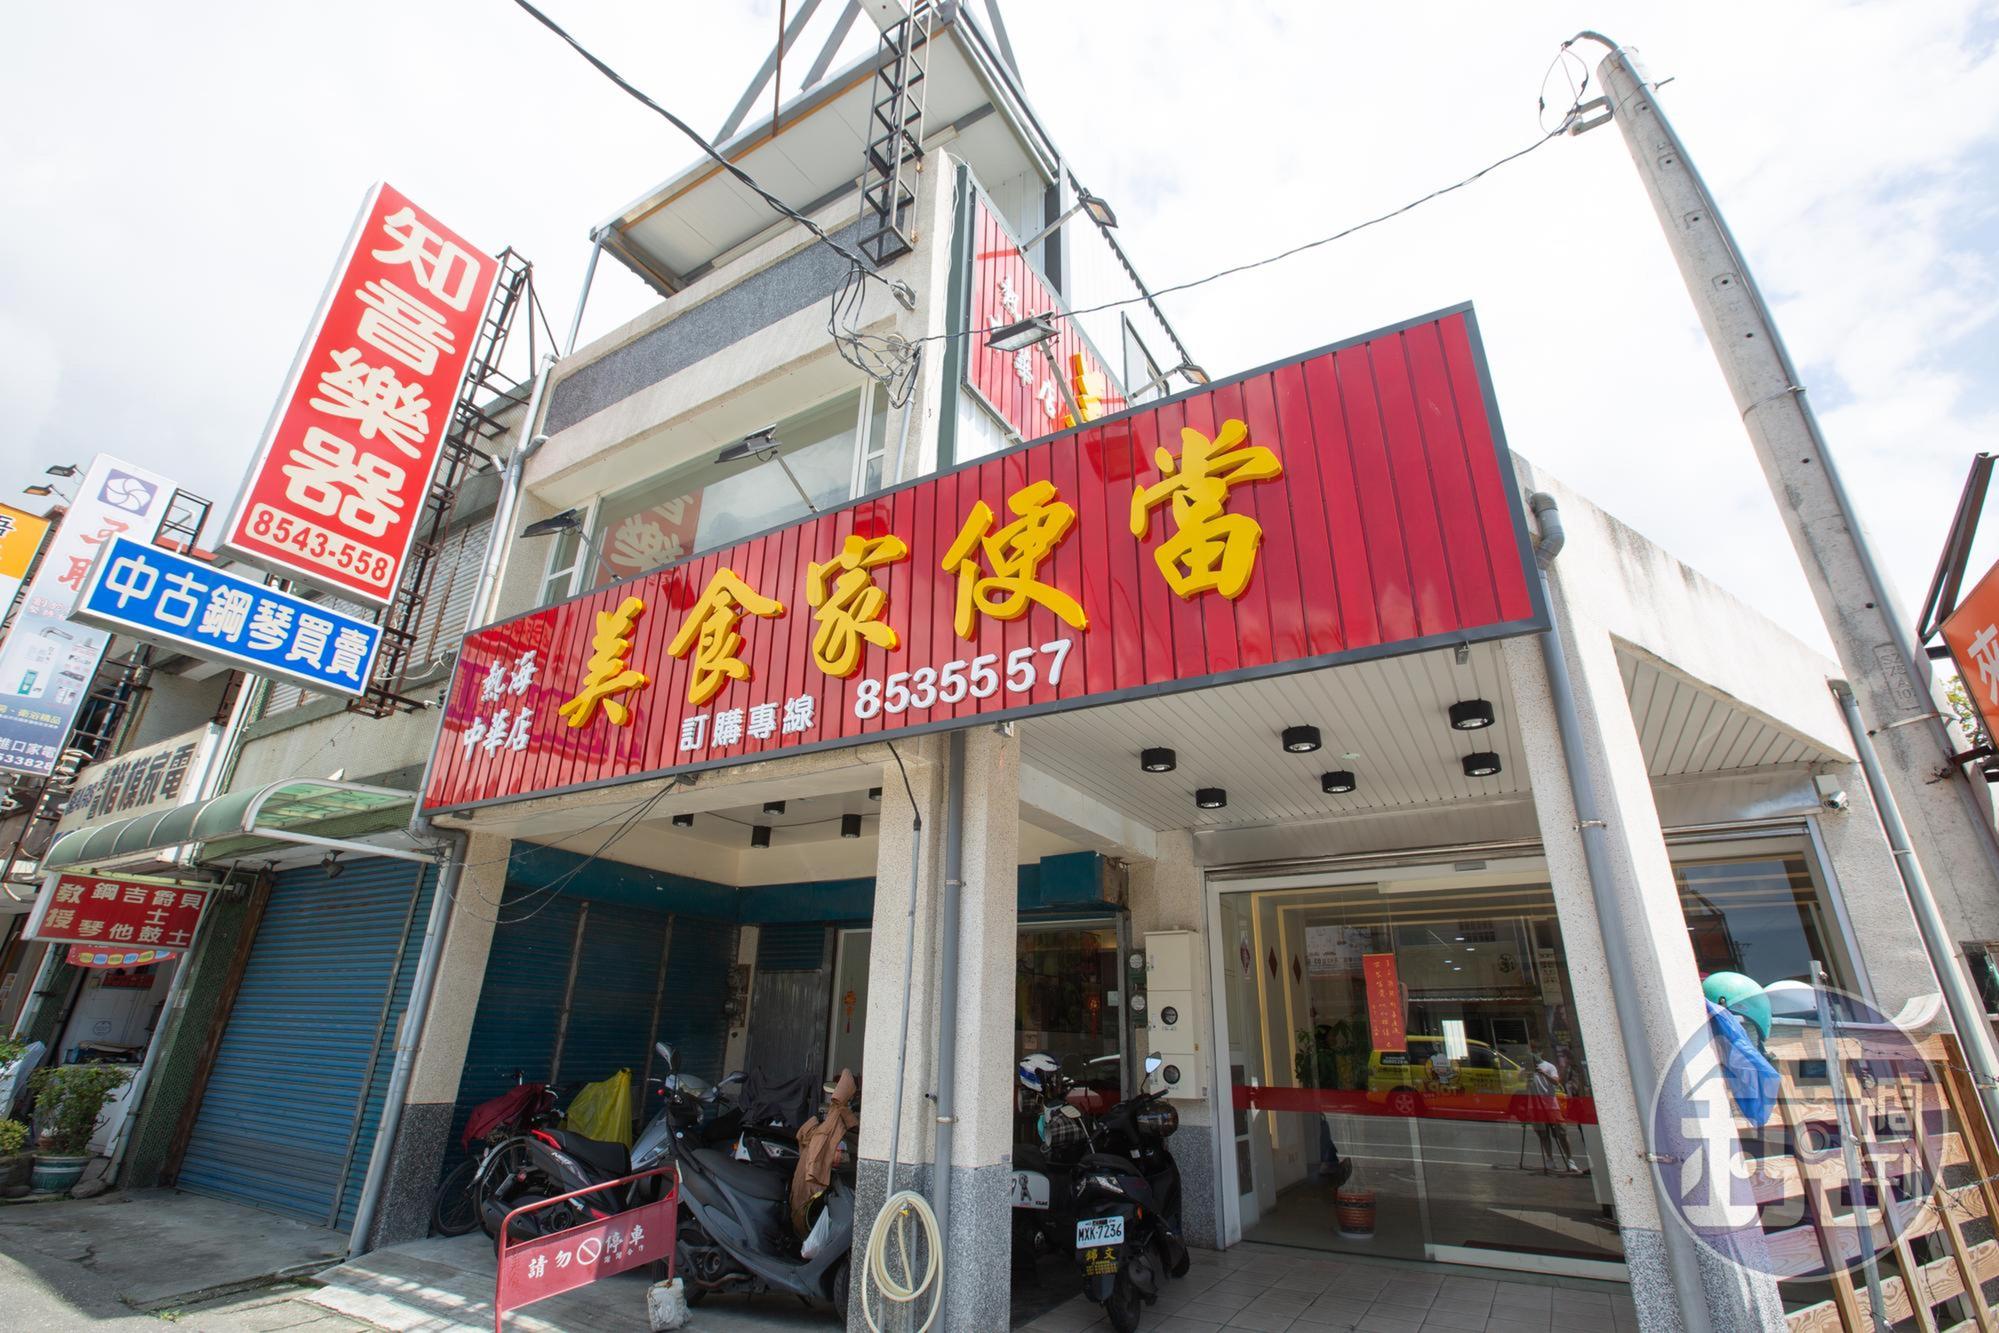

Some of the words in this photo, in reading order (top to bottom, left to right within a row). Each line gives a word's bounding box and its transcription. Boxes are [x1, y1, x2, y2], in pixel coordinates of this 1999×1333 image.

[281, 206, 481, 539] 知音樂器
[252, 510, 389, 584] 8543-558
[559, 418, 1283, 728] 美食家便當
[105, 554, 371, 683] 中古鋼琴買賣
[481, 650, 538, 702] 熱海
[854, 639, 1072, 719] 8535557
[464, 706, 534, 761] 中華店
[680, 693, 817, 752] 訂購專線
[78, 882, 120, 937] 鋼琴
[109, 887, 148, 940] 吉他
[137, 890, 177, 943] 爵士鼓
[166, 893, 203, 946] 貝士
[528, 1250, 573, 1279] 請勿
[606, 1224, 645, 1255] 停車
[1078, 1223, 1122, 1242] MXK-7236
